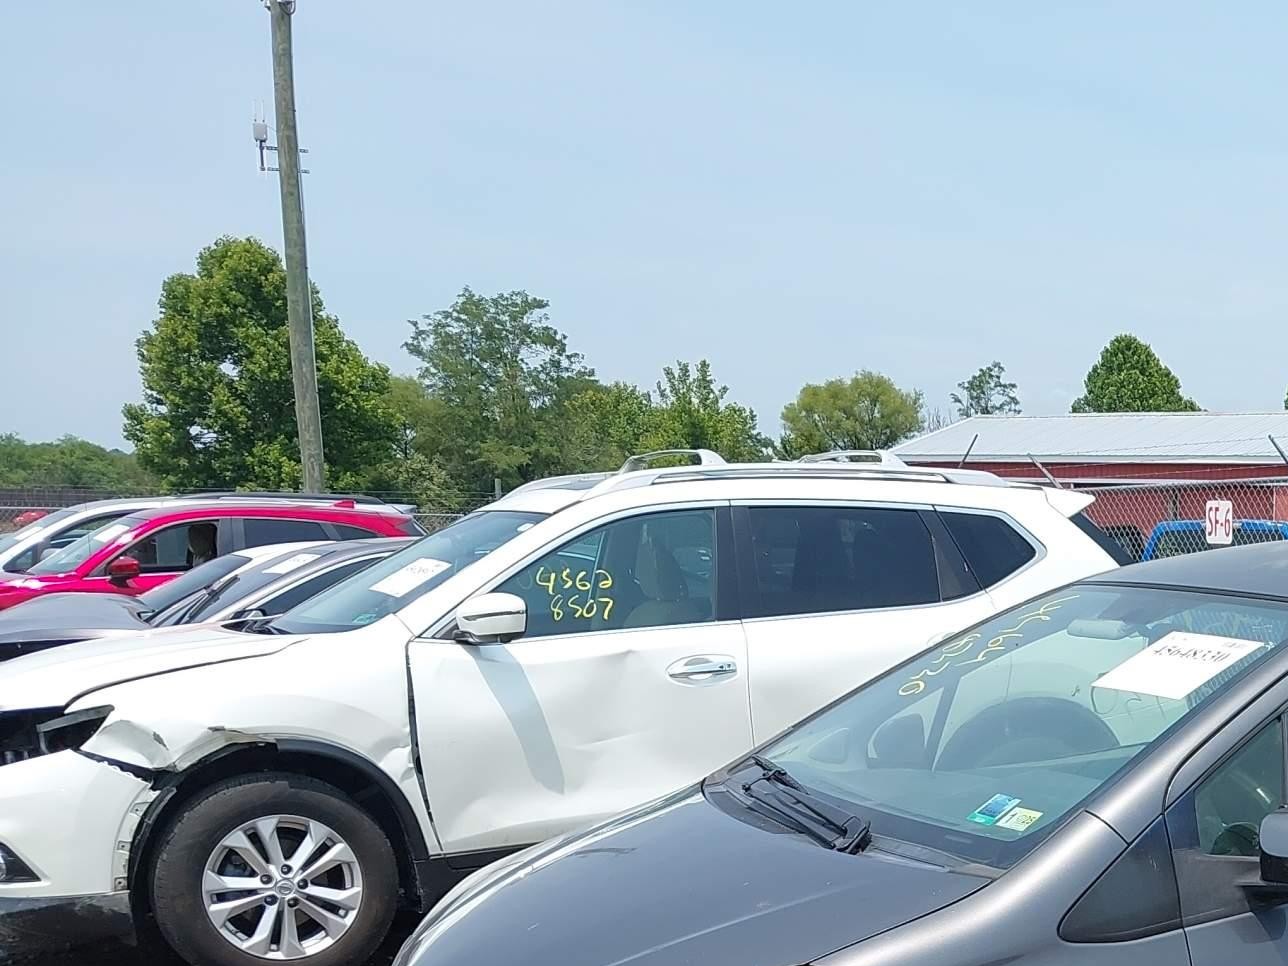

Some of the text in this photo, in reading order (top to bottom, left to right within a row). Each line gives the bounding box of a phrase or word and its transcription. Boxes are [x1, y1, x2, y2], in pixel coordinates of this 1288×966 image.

[1207, 506, 1231, 537] SF-6
[536, 566, 612, 595] 4562
[551, 594, 614, 621] 8507
